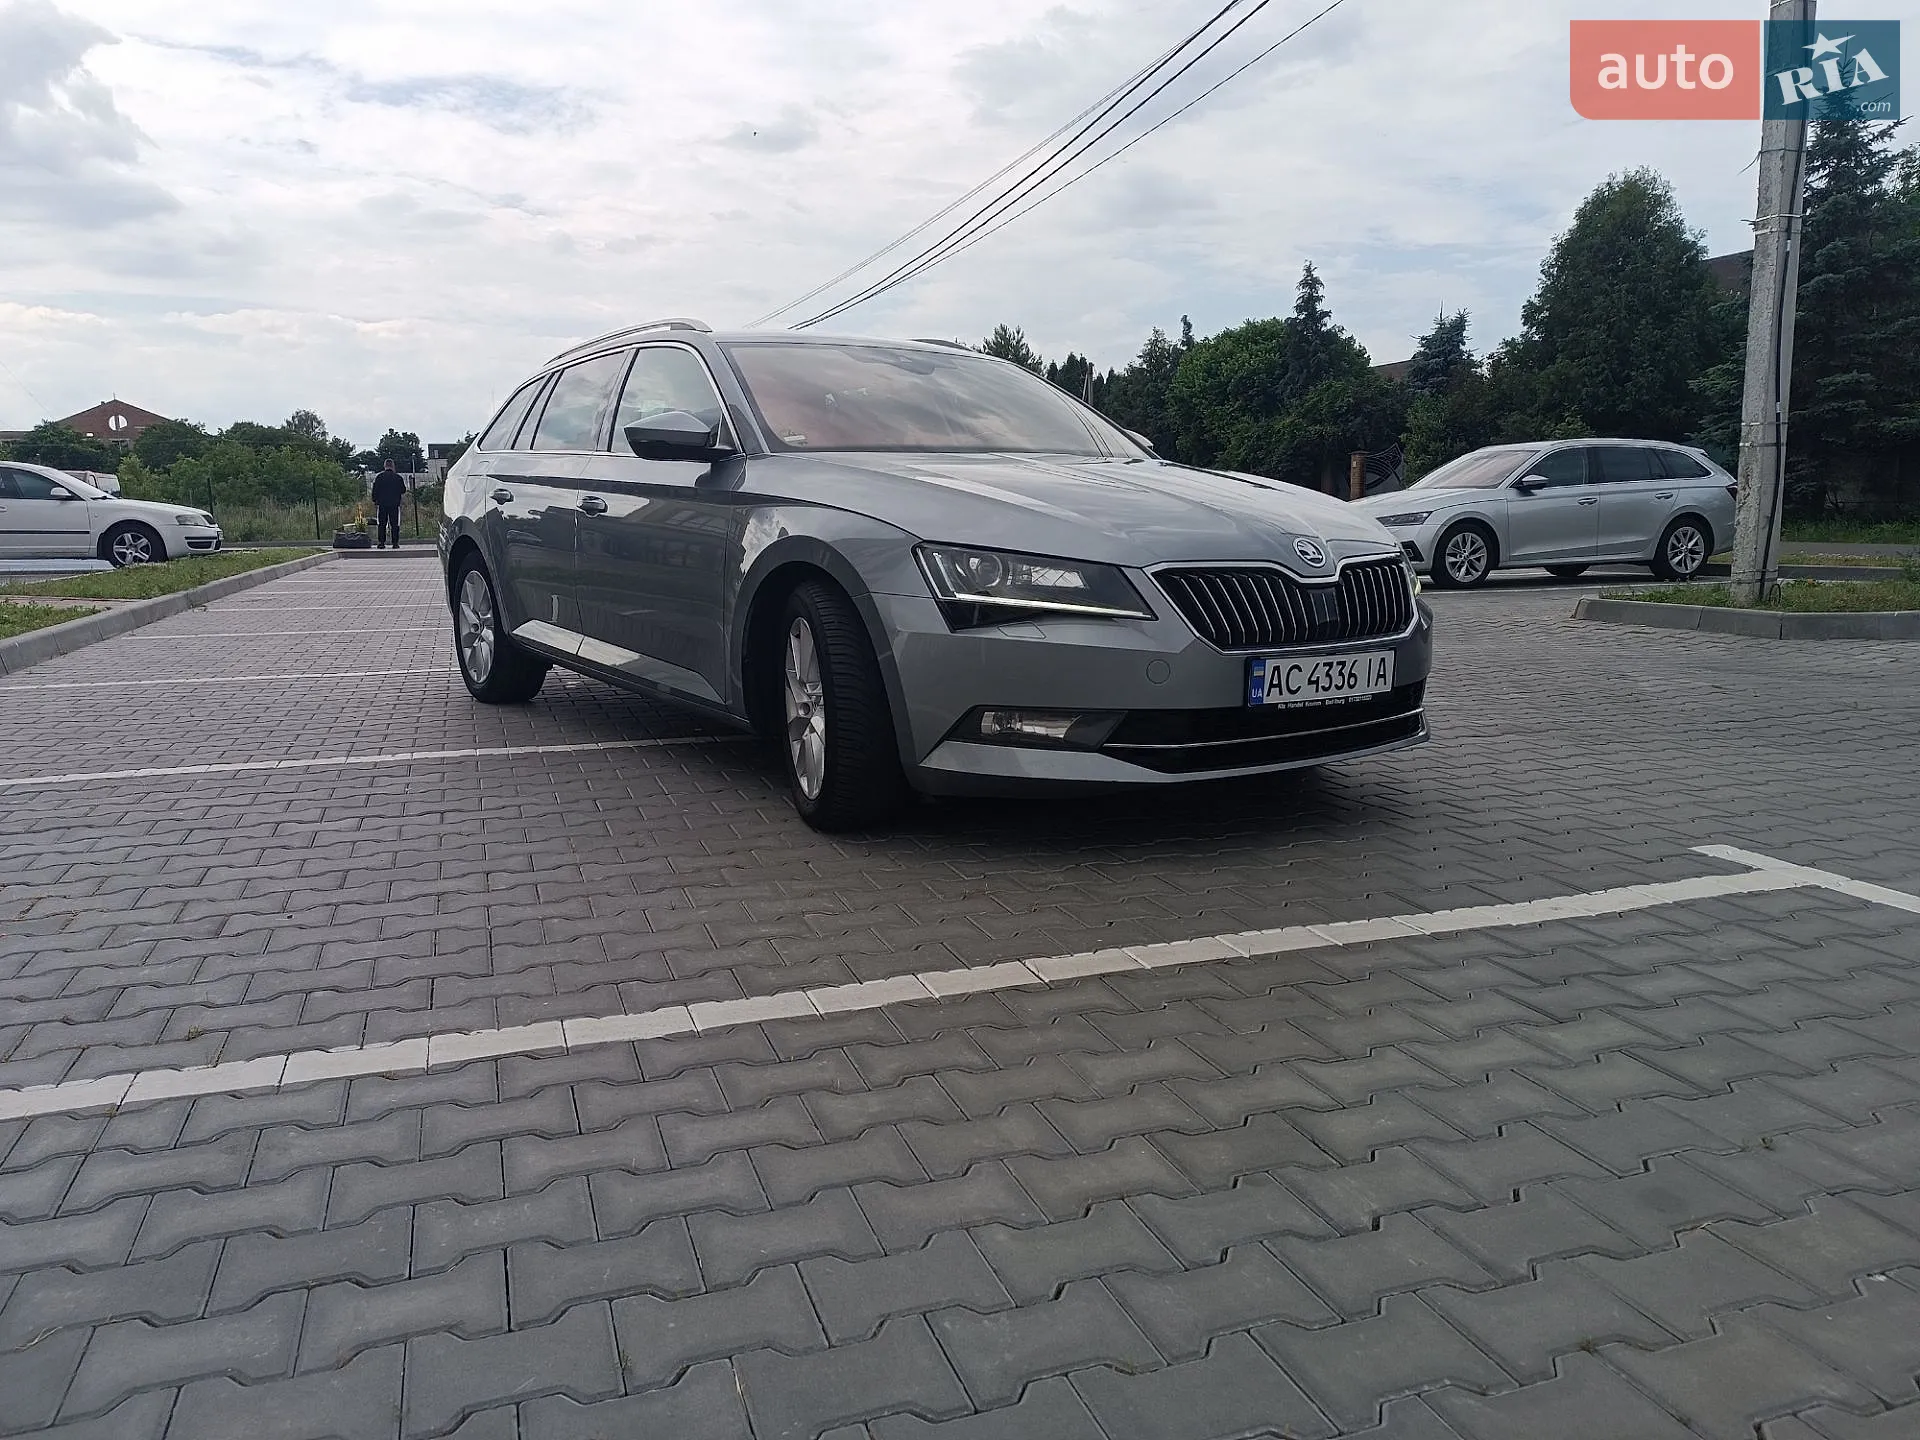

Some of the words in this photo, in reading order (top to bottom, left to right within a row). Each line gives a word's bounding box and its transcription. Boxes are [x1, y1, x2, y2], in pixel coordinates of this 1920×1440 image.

[1266, 664, 1303, 697] AC
[1307, 660, 1358, 693] 4336
[1367, 657, 1387, 688] IA
[1252, 688, 1263, 698] UA
